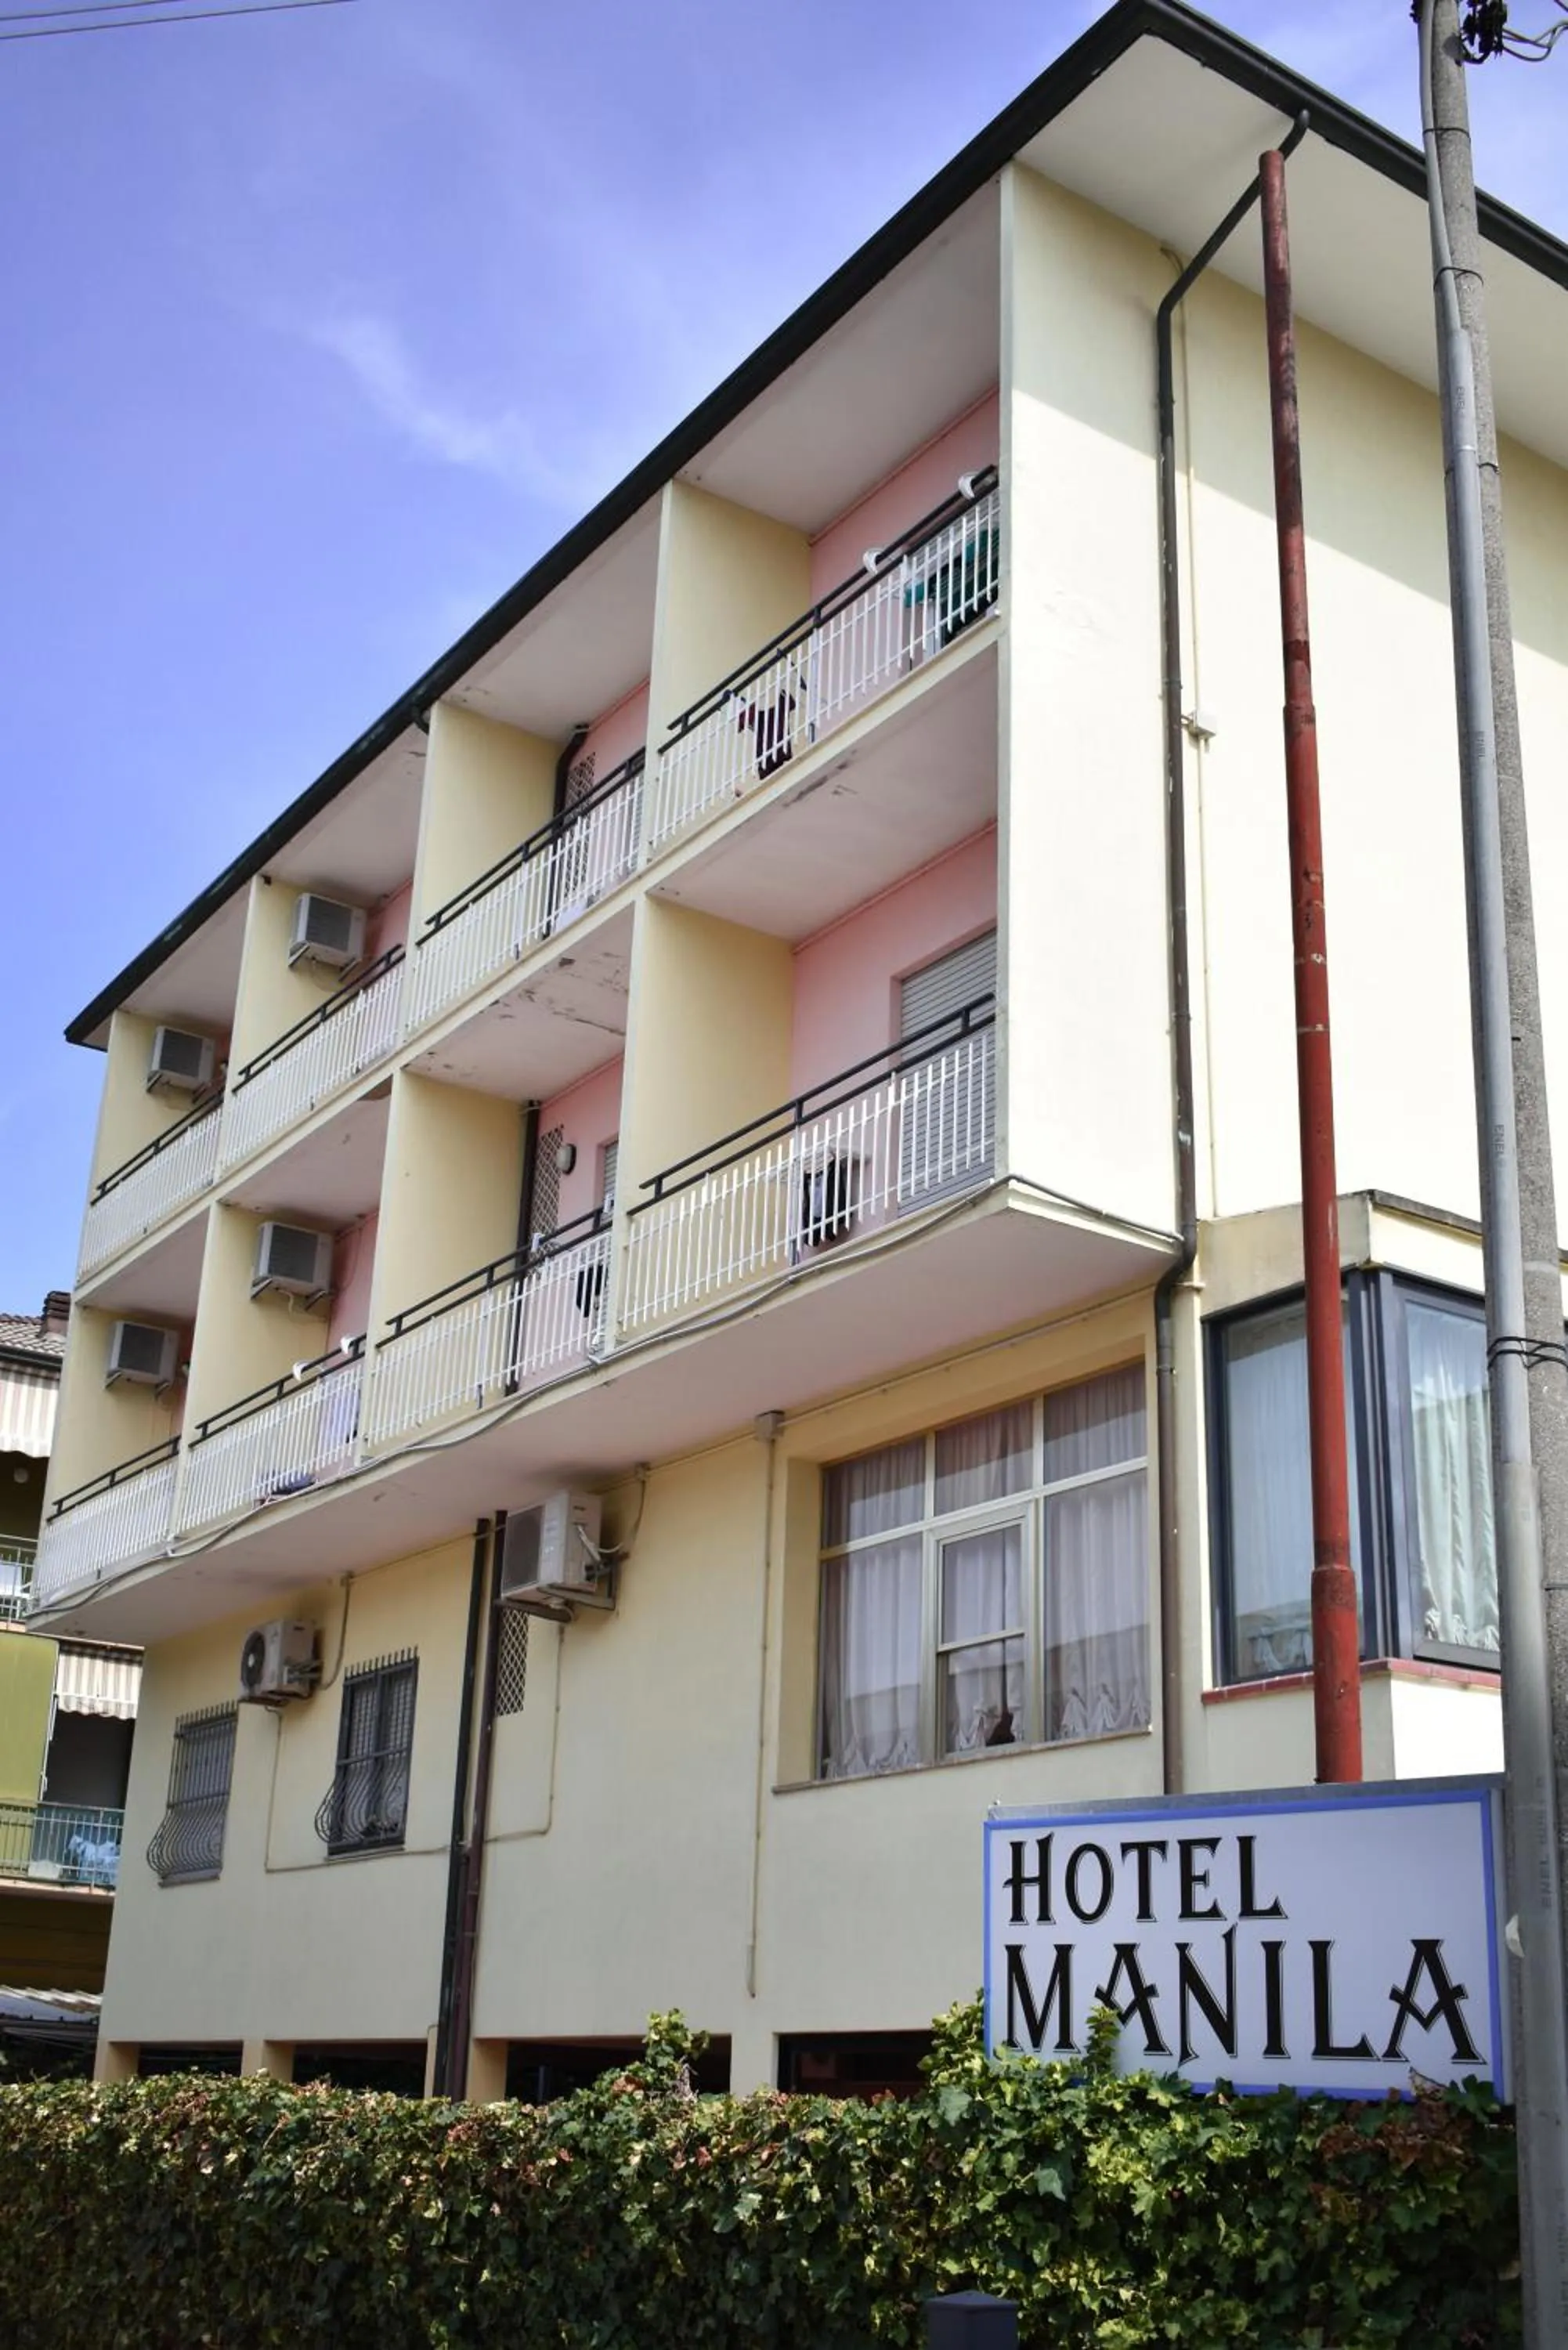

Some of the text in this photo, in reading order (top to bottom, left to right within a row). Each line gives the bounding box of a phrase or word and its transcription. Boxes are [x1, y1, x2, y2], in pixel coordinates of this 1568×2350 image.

[1493, 1123, 1505, 1159] ENEL
[1003, 1831, 1288, 1925] HOTEL
[1539, 1853, 1552, 1908] ENEL
[1004, 1922, 1487, 2068] MANILA
